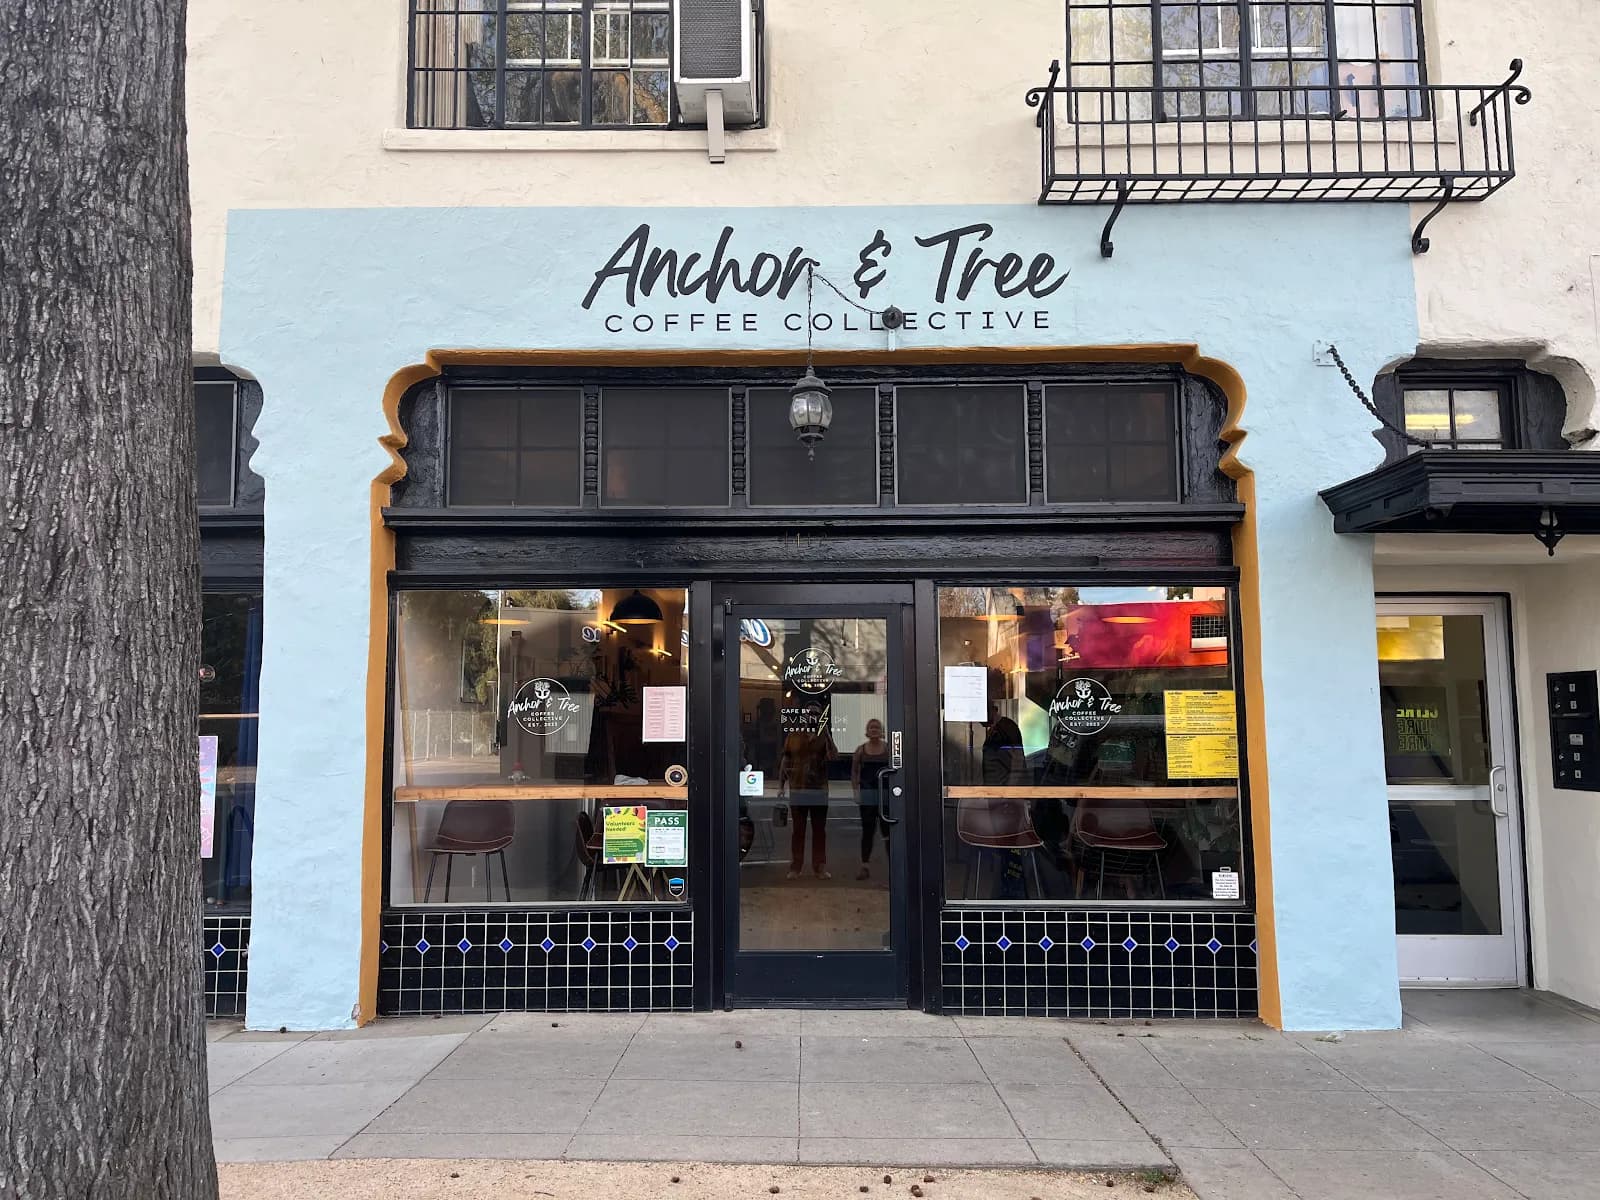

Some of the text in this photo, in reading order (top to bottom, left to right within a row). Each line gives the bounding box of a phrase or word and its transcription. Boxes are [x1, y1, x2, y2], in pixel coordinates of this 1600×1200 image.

[581, 223, 1071, 310] Anchor & Tree
[604, 311, 1050, 332] COFFEE COLLECTIVE
[784, 663, 812, 680] Anchor
[507, 697, 543, 719] Anchor
[557, 697, 580, 713] Tree
[1048, 696, 1122, 717] Anchor & Tree
[654, 817, 680, 825] PASS
